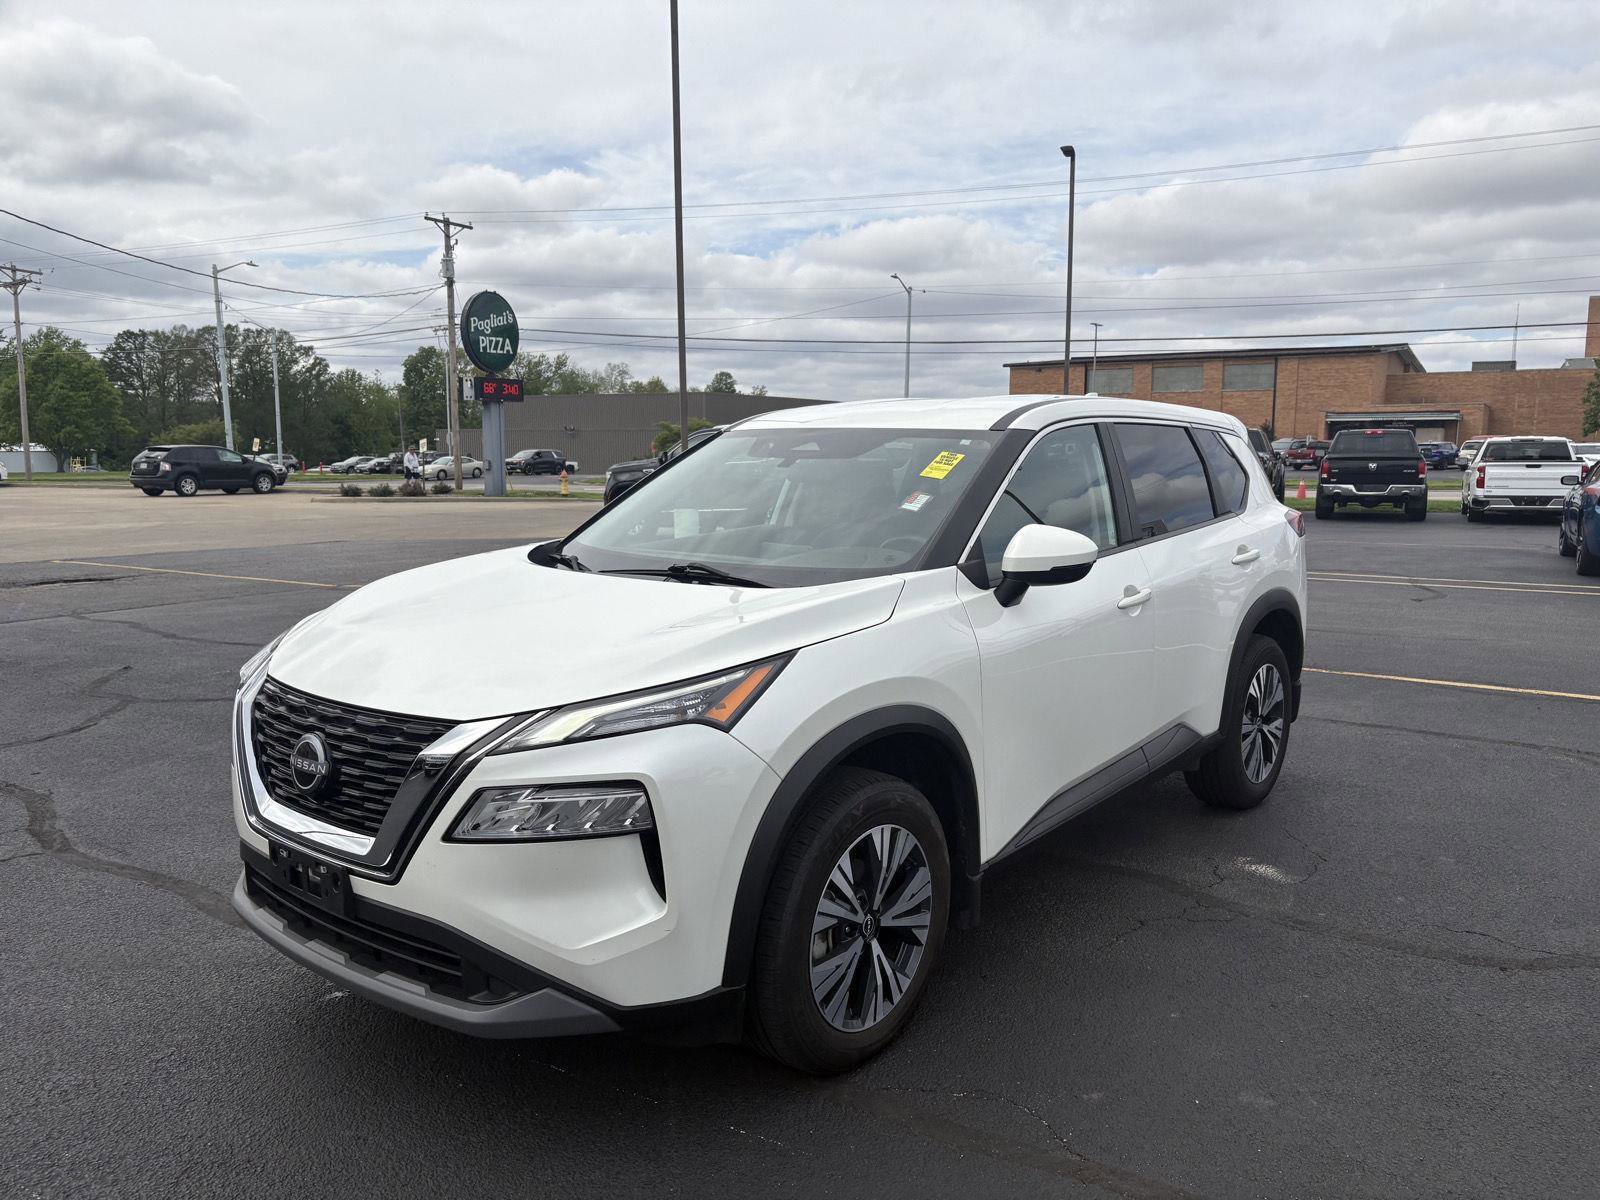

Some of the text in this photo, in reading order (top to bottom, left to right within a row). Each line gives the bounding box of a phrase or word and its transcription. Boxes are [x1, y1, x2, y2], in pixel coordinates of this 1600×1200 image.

[470, 311, 513, 334] Pagliai's
[479, 336, 513, 354] PIZZA
[290, 754, 326, 774] NISSAN
